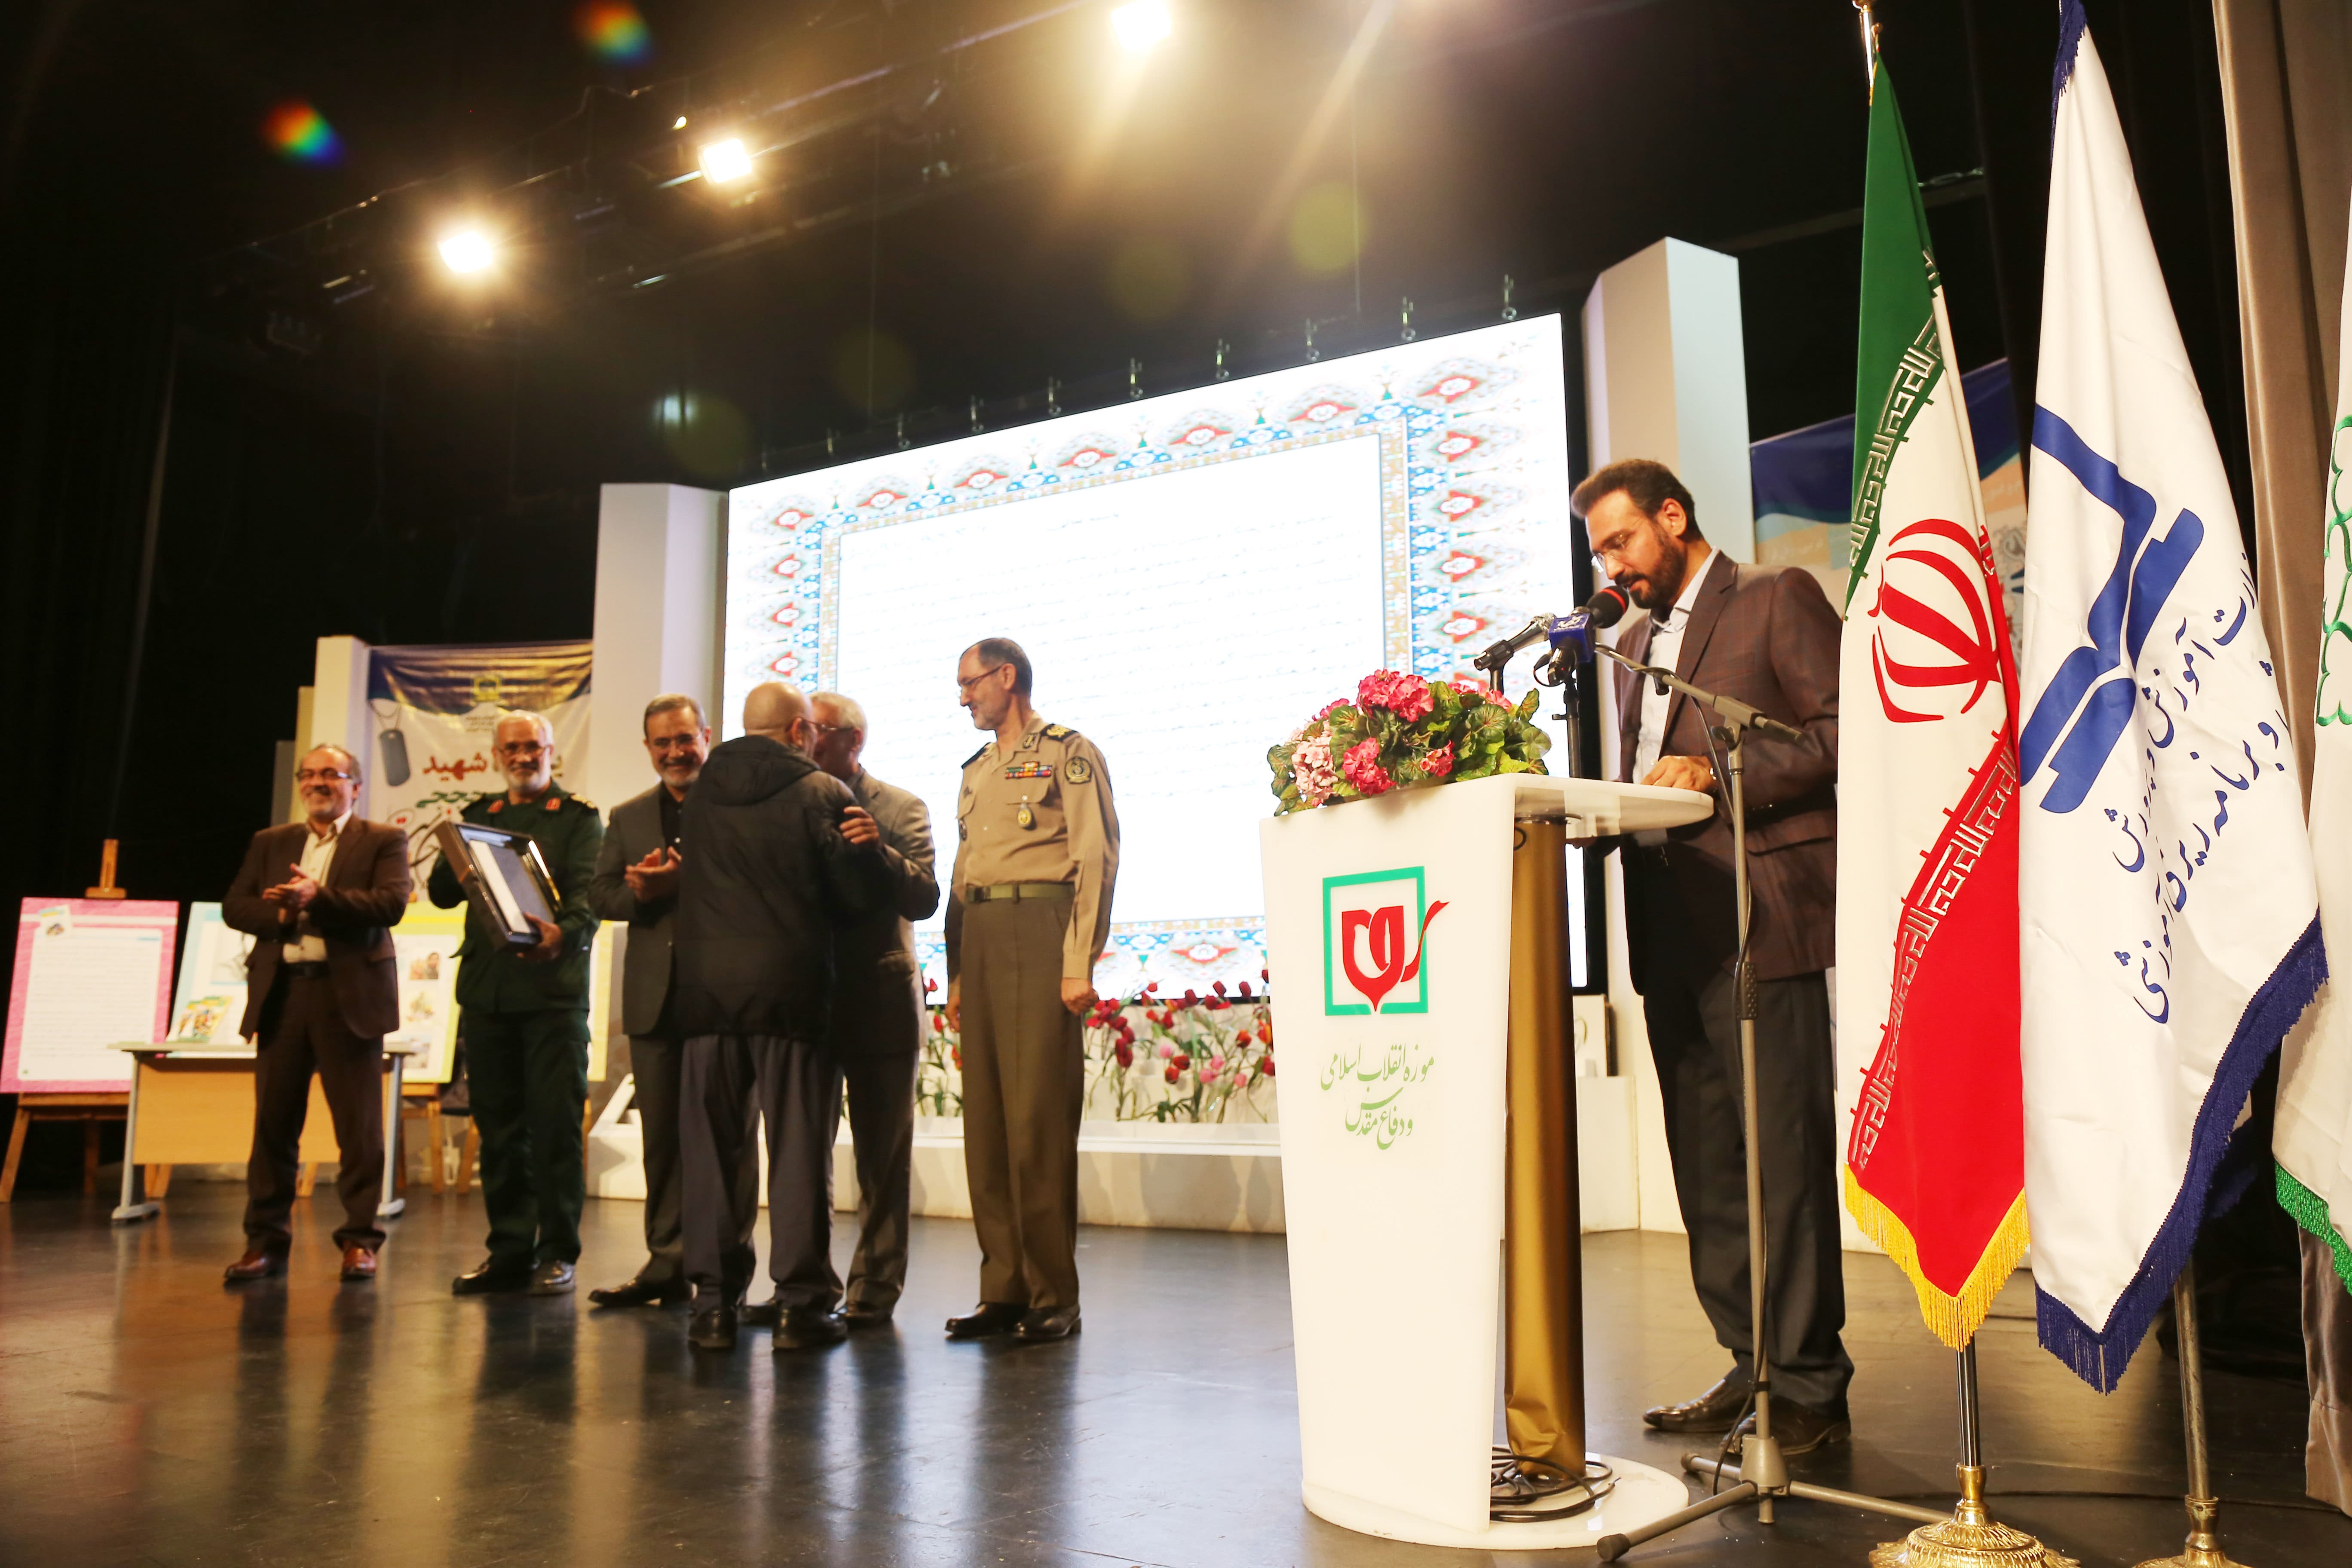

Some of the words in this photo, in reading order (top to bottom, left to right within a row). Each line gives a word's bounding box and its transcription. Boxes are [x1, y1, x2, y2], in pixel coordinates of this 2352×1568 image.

[2141, 617, 2215, 748] آموزش
[423, 753, 487, 781] شهید
[2113, 872, 2174, 1024] آموزشی
[1321, 1042, 1362, 1090] اسلامی
[1357, 1042, 1406, 1092] انقلاب
[1403, 1044, 1434, 1082] موزه
[1345, 1086, 1404, 1136] مقدس
[1377, 1105, 1405, 1150] دفاع
[1406, 1119, 1413, 1136] و
